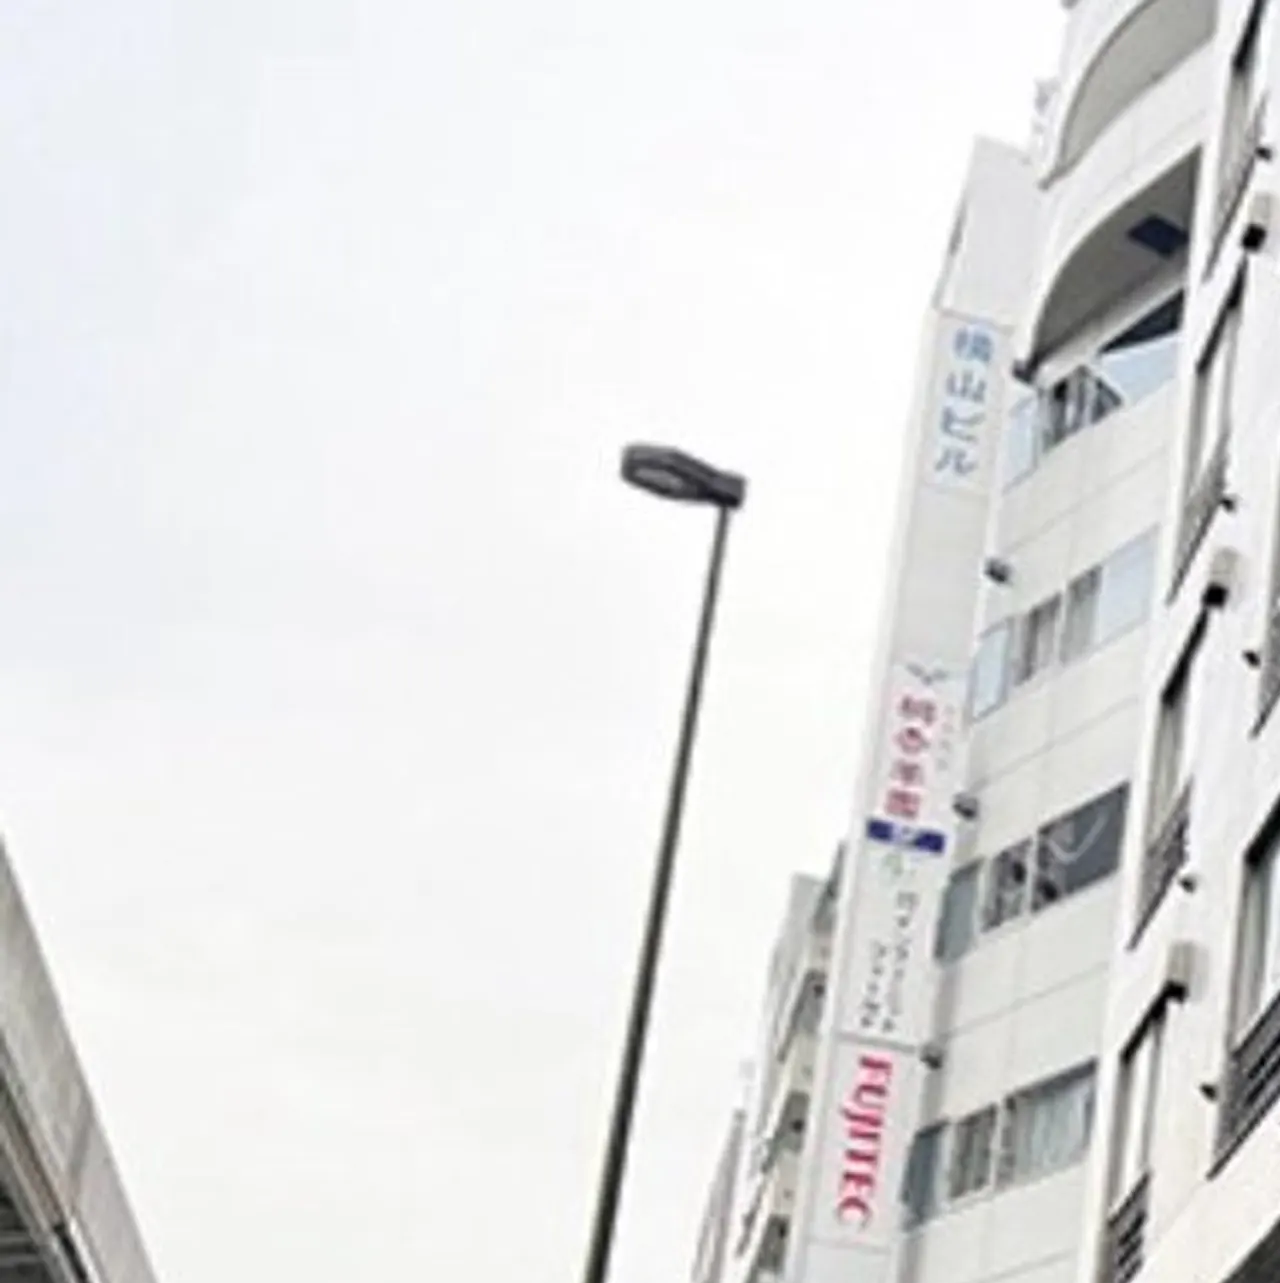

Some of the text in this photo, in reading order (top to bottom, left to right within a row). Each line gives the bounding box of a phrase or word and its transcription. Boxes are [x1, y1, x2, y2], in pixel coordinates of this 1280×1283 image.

[933, 326, 994, 477] 横山ビル
[838, 1055, 893, 1232] FUJITEC
